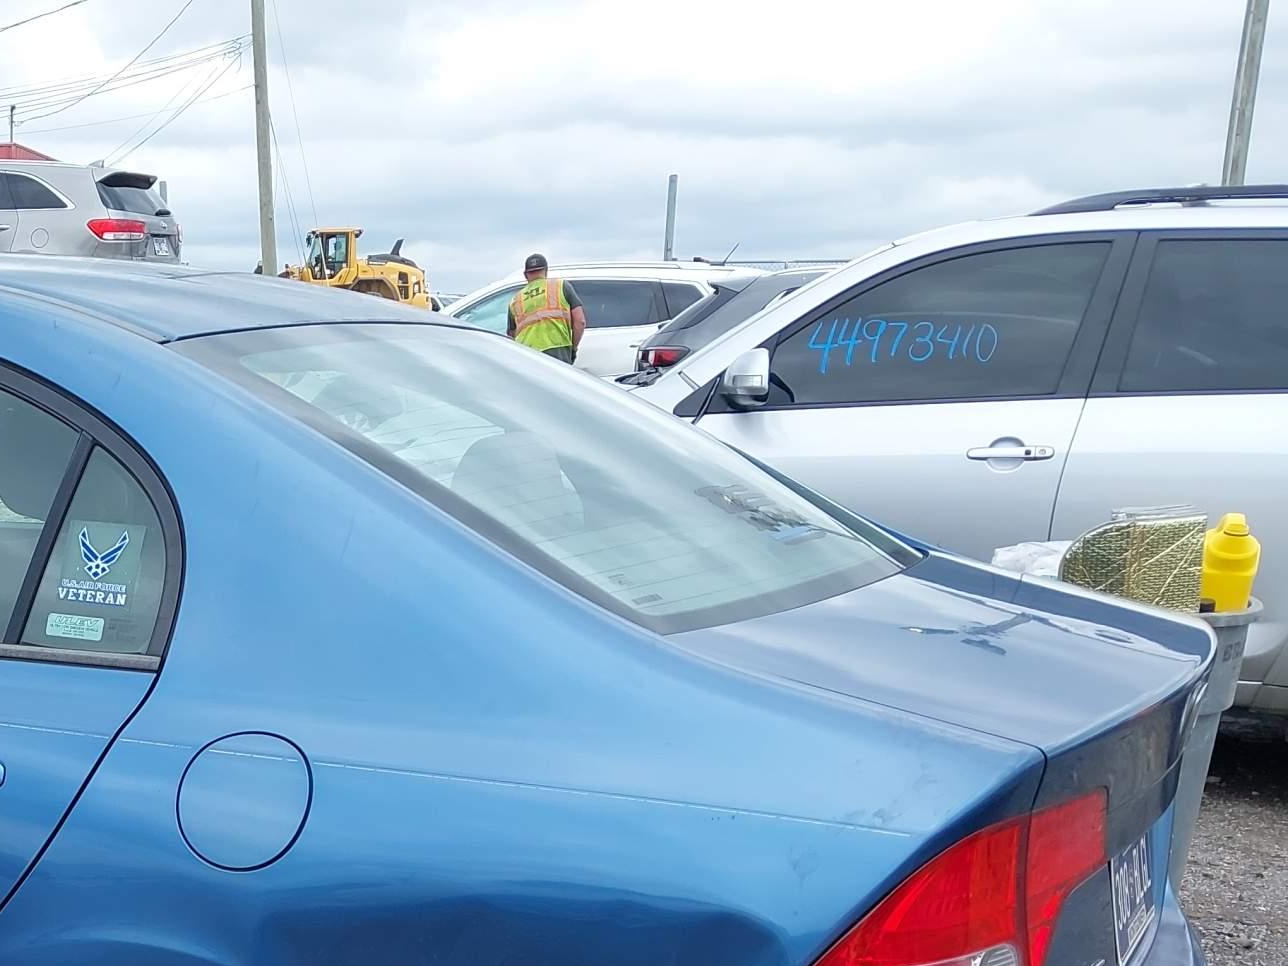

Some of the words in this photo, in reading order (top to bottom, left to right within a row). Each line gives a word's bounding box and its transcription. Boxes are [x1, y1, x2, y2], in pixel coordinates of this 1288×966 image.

[808, 317, 998, 375] 44973410
[58, 586, 127, 606] VETERAN
[79, 580, 94, 590] AIR
[95, 581, 127, 593] FORCE
